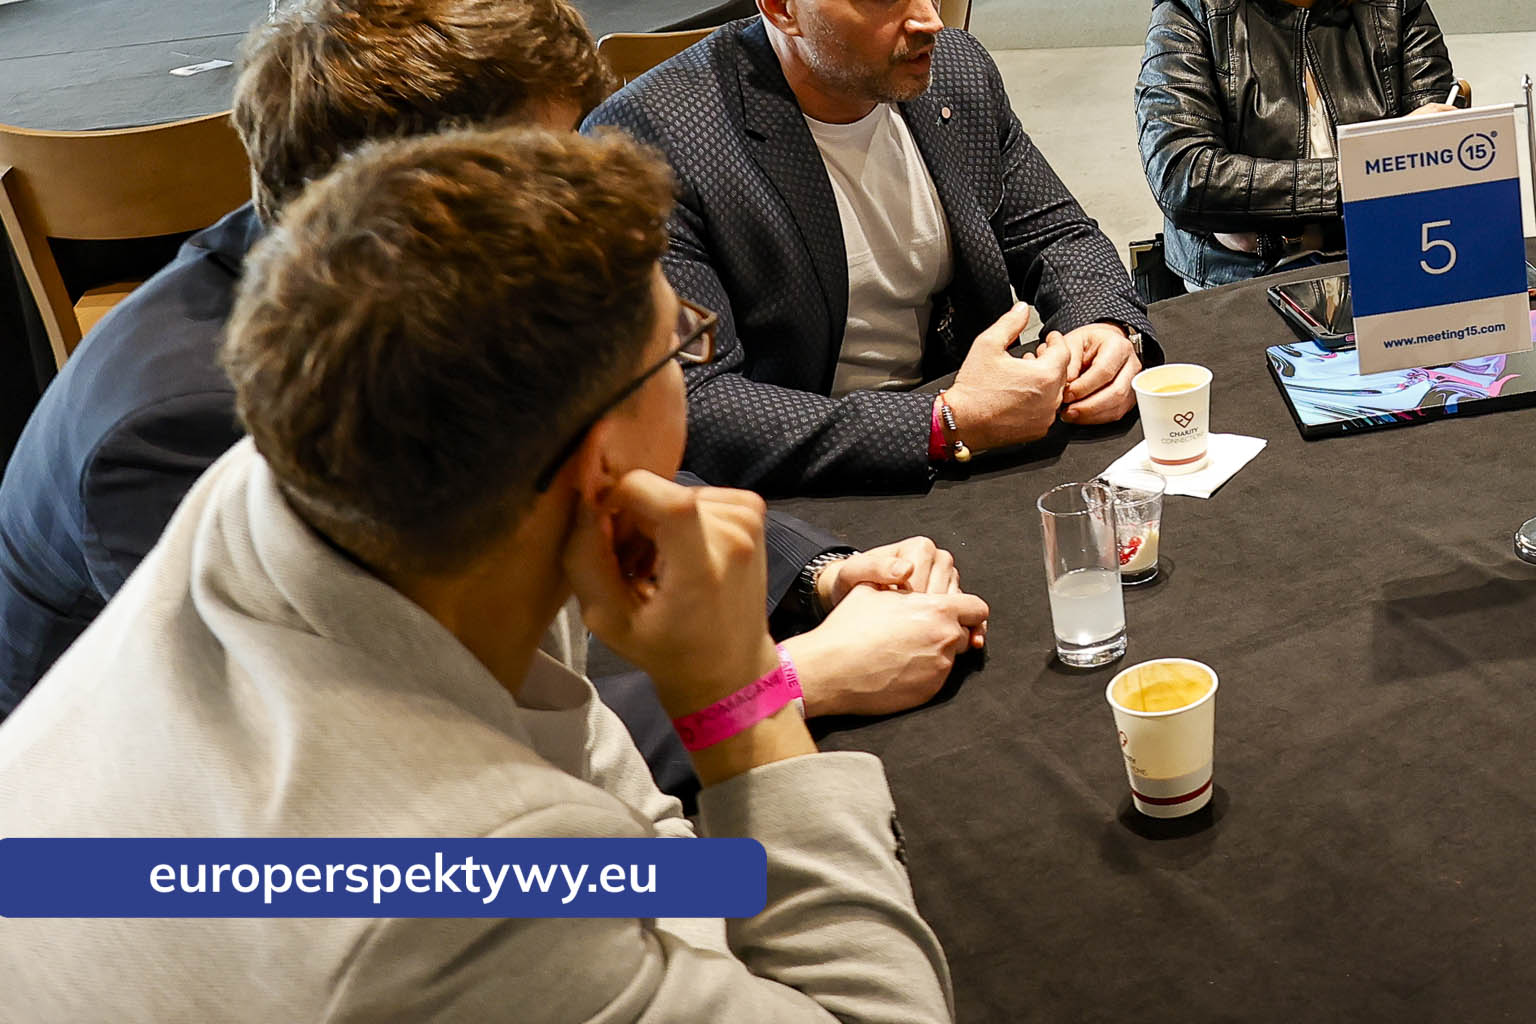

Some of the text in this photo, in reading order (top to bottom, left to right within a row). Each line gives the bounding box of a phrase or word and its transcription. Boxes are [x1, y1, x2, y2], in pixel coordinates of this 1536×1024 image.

[1365, 143, 1488, 175] MEETING 15
[1419, 219, 1458, 275] 5
[1383, 321, 1507, 349] www.meeting15.com
[1169, 426, 1199, 437] CHARITY
